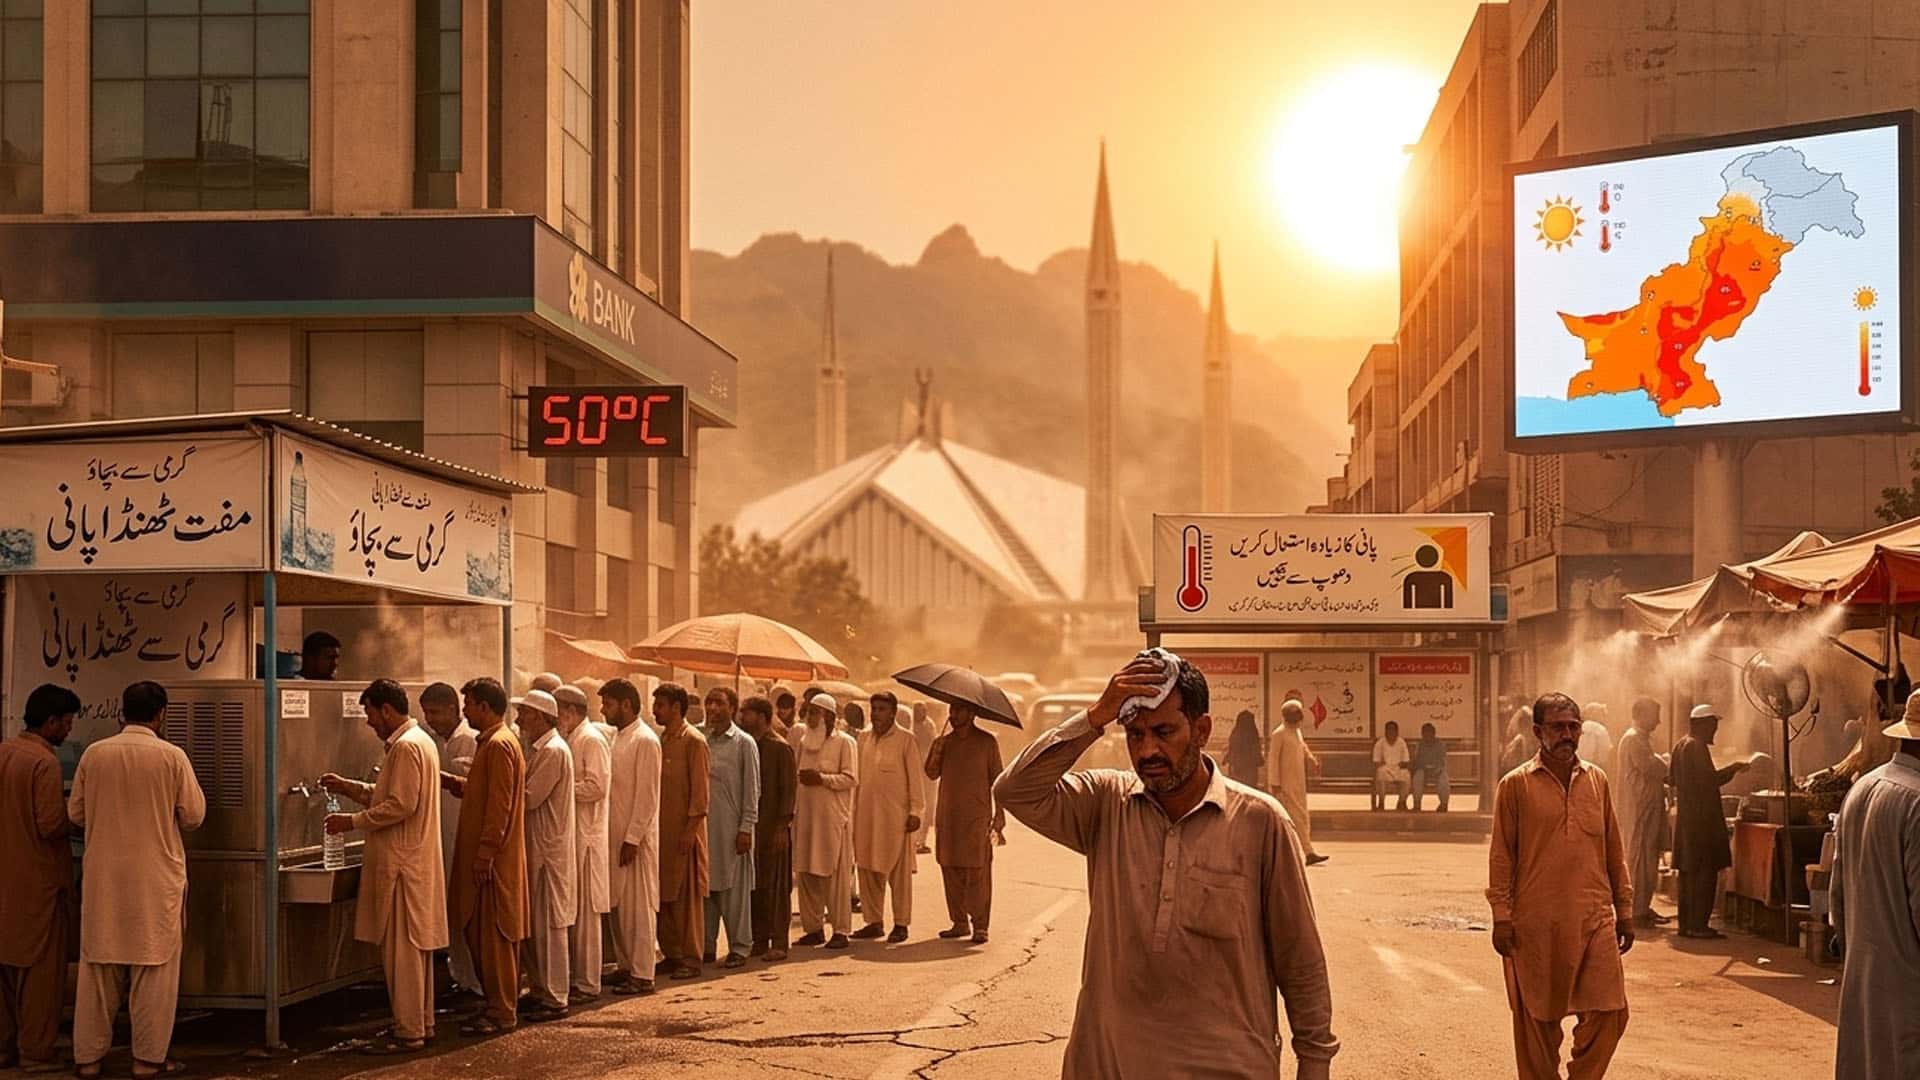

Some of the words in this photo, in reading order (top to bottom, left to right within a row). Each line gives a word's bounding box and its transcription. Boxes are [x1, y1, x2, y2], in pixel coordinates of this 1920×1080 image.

[593, 280, 635, 345] BANK
[120, 465, 151, 479] سے
[153, 446, 196, 483] گرمی
[47, 482, 98, 564] پانی
[174, 500, 252, 541] مفت
[384, 535, 415, 560] سے
[416, 509, 455, 572] گرمی
[1230, 529, 1269, 558] کریں
[1355, 527, 1377, 562] پانی
[133, 591, 160, 604] سے
[161, 577, 195, 610] گرمی
[42, 591, 79, 683] پانی
[138, 637, 180, 661] سے
[185, 601, 236, 671] گرمی
